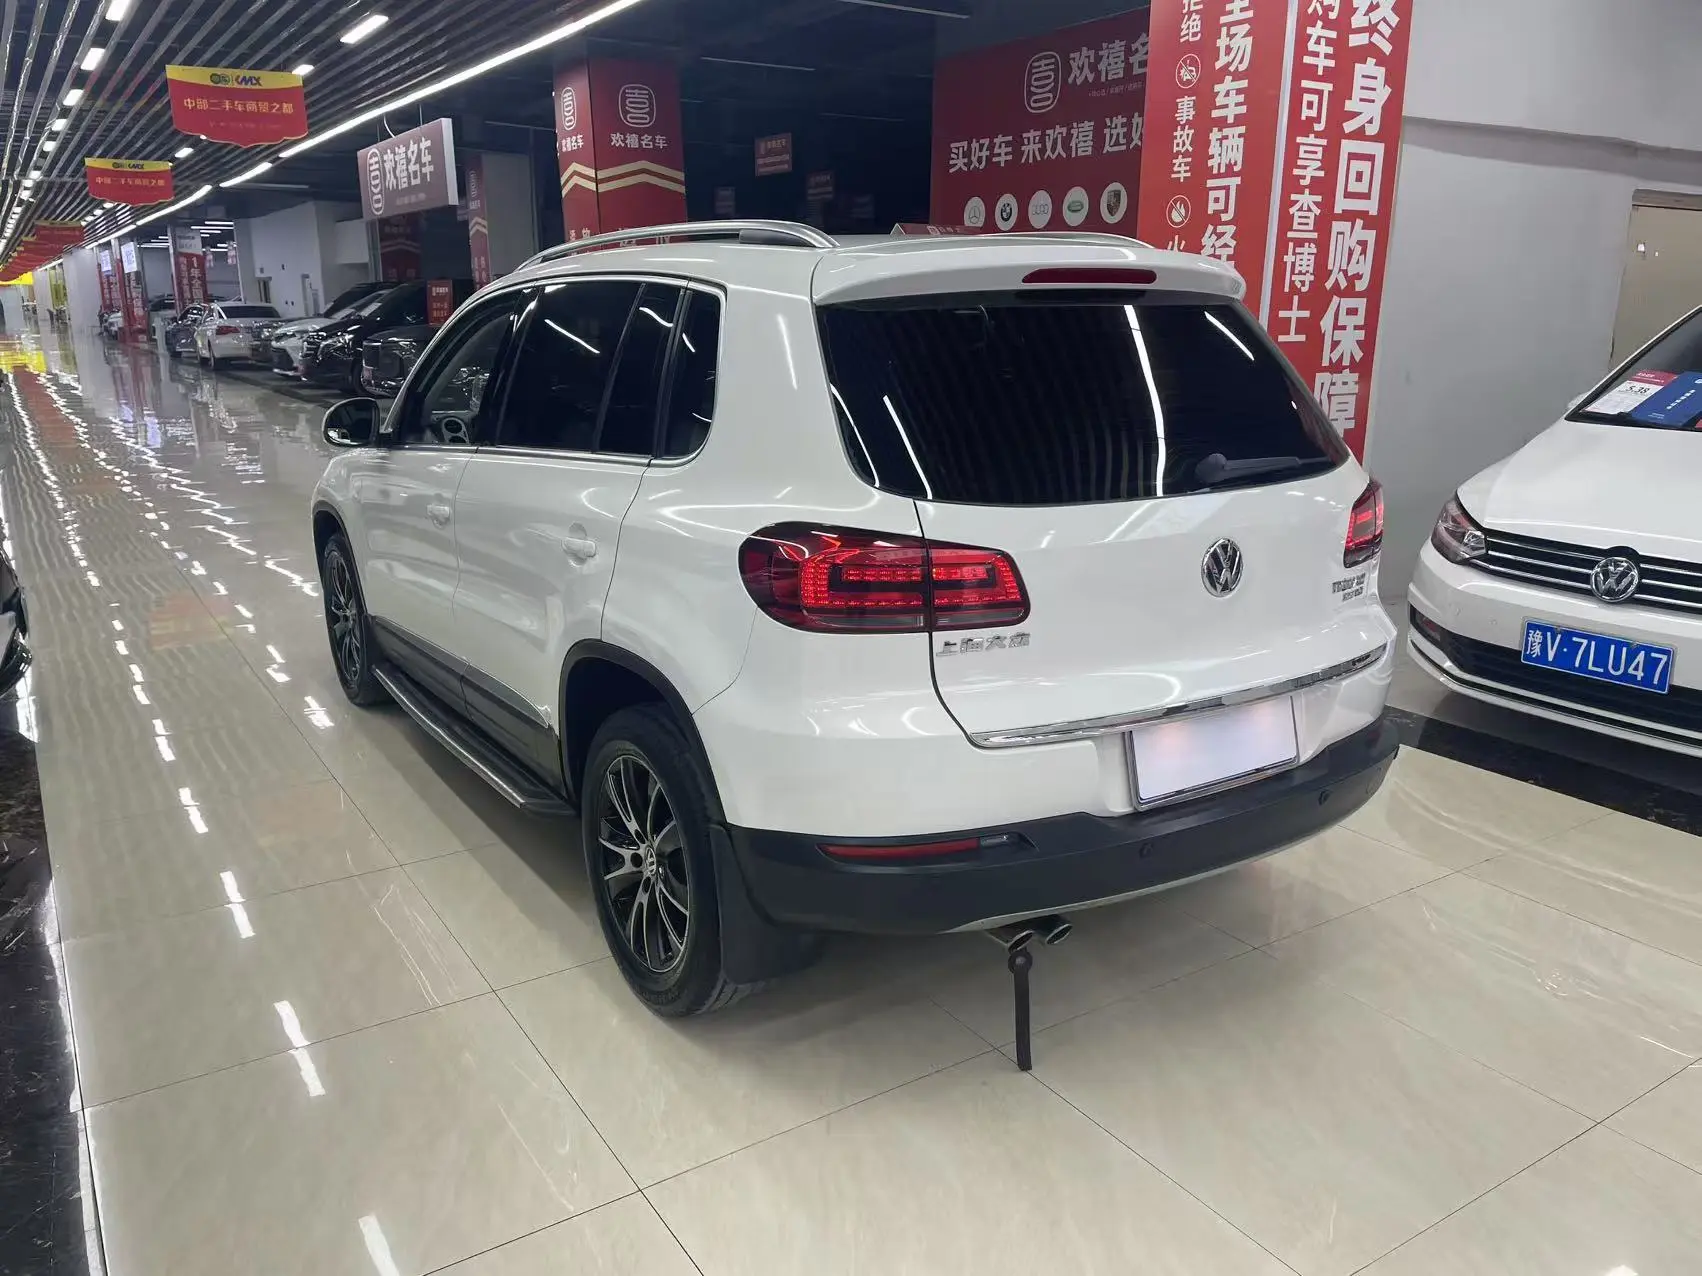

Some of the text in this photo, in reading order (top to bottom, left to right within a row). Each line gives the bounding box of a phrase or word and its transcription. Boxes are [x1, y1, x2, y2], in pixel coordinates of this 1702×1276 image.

[183, 97, 294, 115] 中部二手车商贸之都
[382, 136, 434, 192] 欢禧名车
[610, 132, 669, 150] 欢禧名车
[948, 134, 1013, 174] 买好车
[1020, 120, 1095, 164] 来欢禧
[1171, 95, 1197, 183] 事故车
[1313, 0, 1400, 440] 终身回购保障
